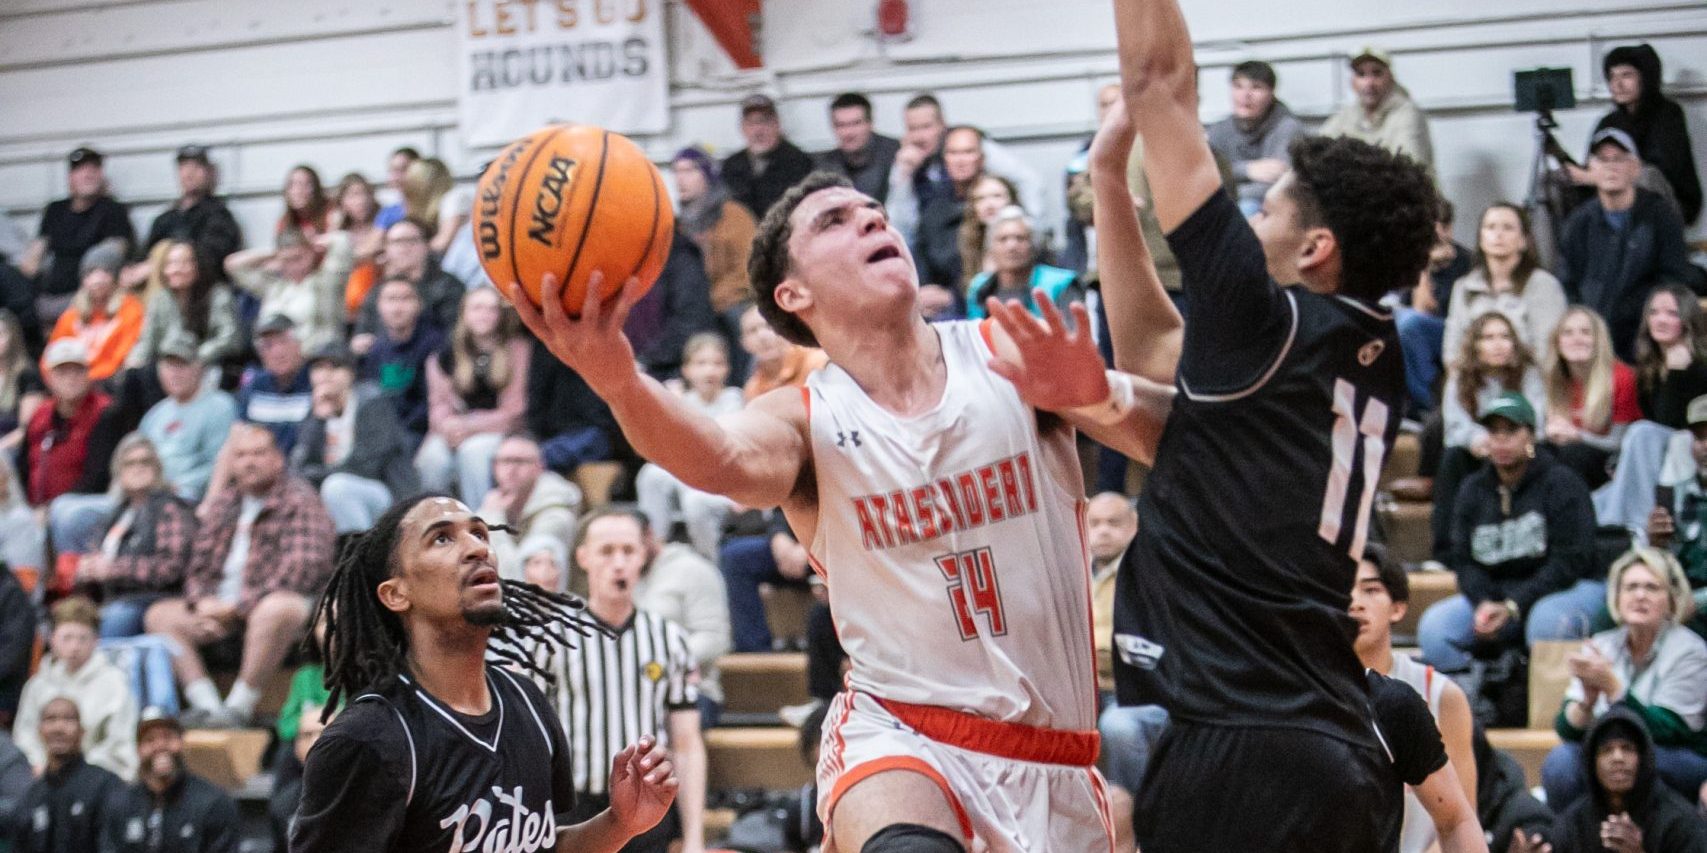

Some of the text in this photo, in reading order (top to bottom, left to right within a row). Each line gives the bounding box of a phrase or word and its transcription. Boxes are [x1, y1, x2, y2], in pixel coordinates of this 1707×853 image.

[471, 38, 648, 91] HOUNDS
[528, 154, 576, 248] NCAA
[1317, 377, 1389, 562] 11
[933, 545, 1008, 642] 24
